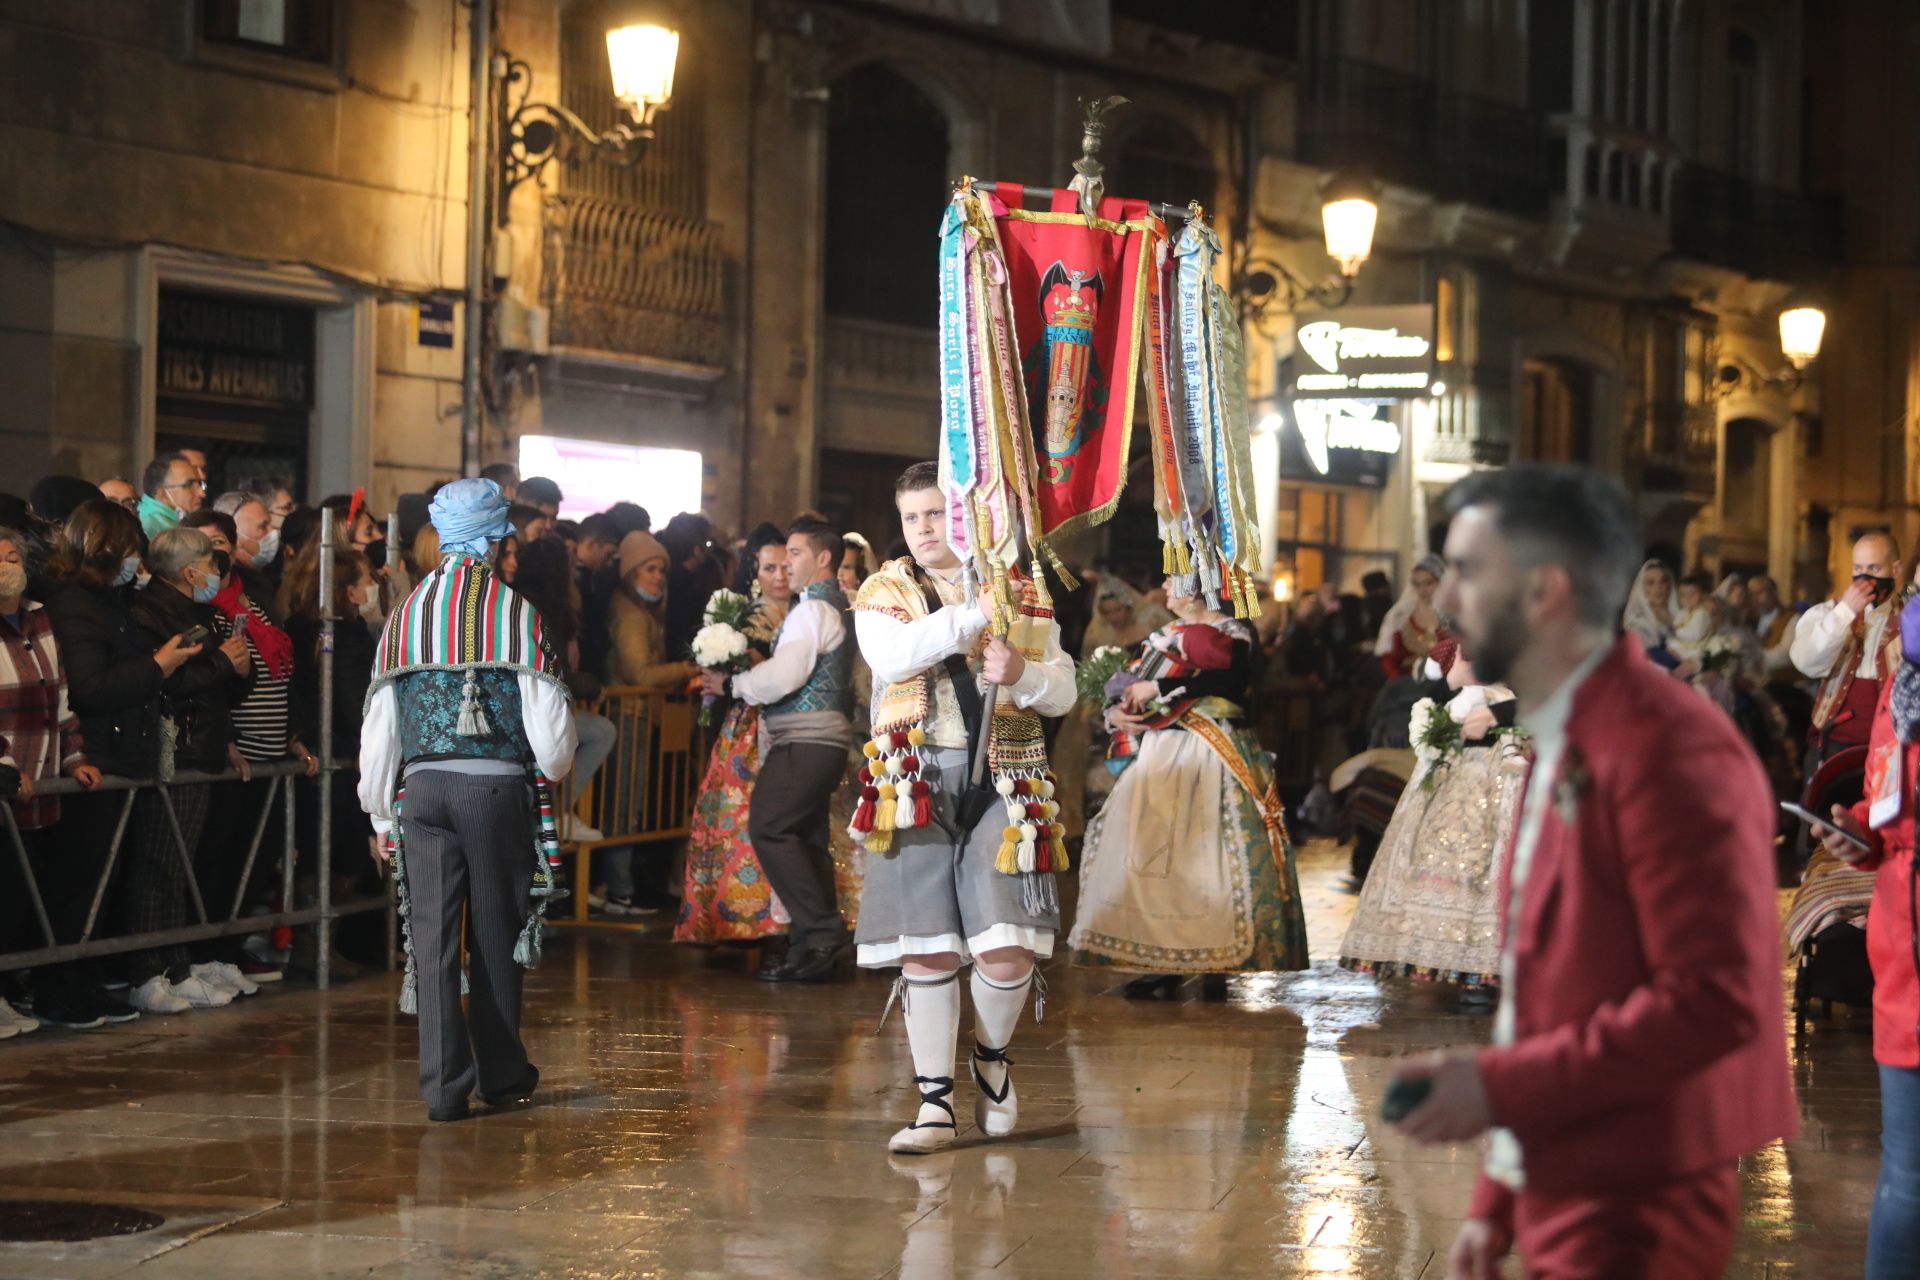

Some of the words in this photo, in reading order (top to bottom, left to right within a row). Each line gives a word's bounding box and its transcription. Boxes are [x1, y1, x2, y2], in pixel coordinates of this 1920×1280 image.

[1185, 292, 1196, 335] Fallera
[994, 316, 1008, 360] Paula
[163, 347, 204, 391] TRES
[209, 352, 305, 401] AVEMARIAS
[1187, 384, 1200, 430] Infantil
[1188, 436, 1200, 465] 2008
